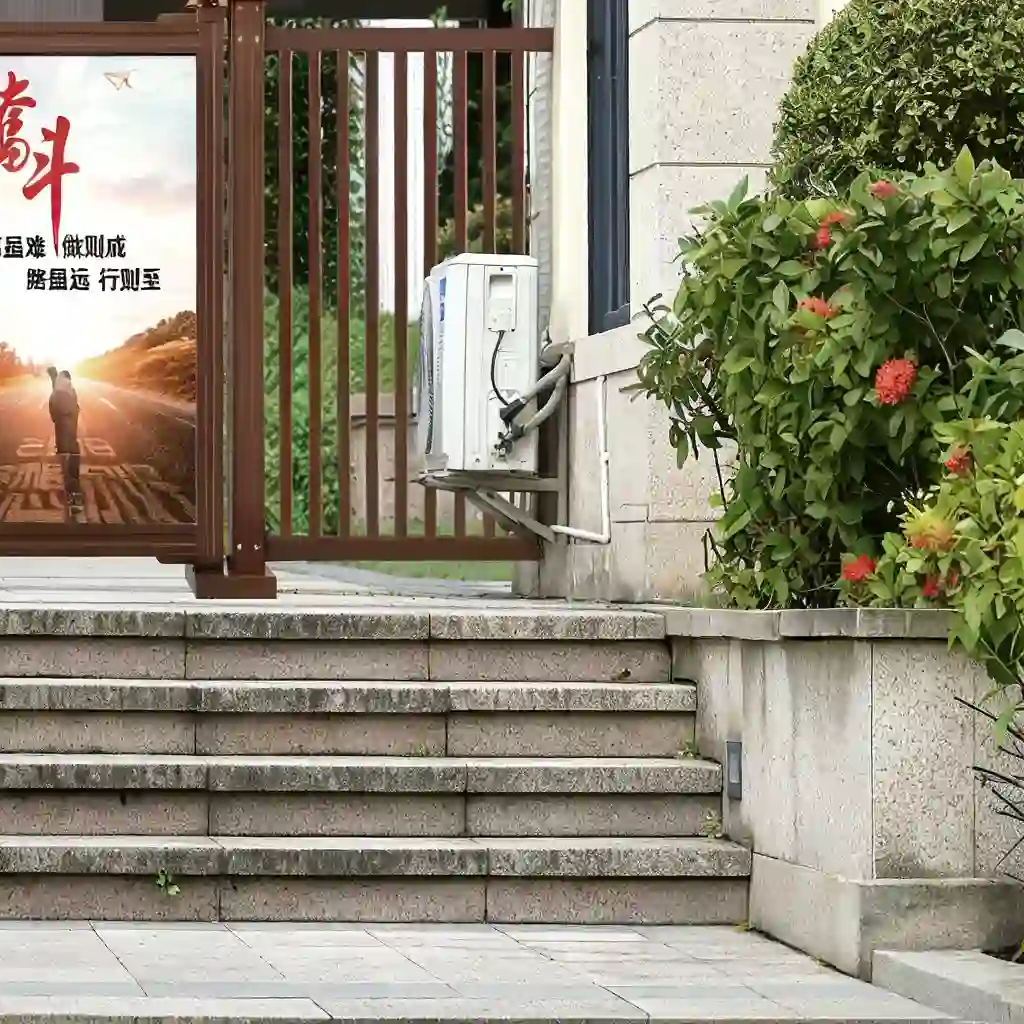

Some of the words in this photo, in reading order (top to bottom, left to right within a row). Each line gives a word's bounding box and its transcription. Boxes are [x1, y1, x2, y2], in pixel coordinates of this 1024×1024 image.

[62, 234, 127, 260] 做则成
[98, 267, 161, 291] 行则至
